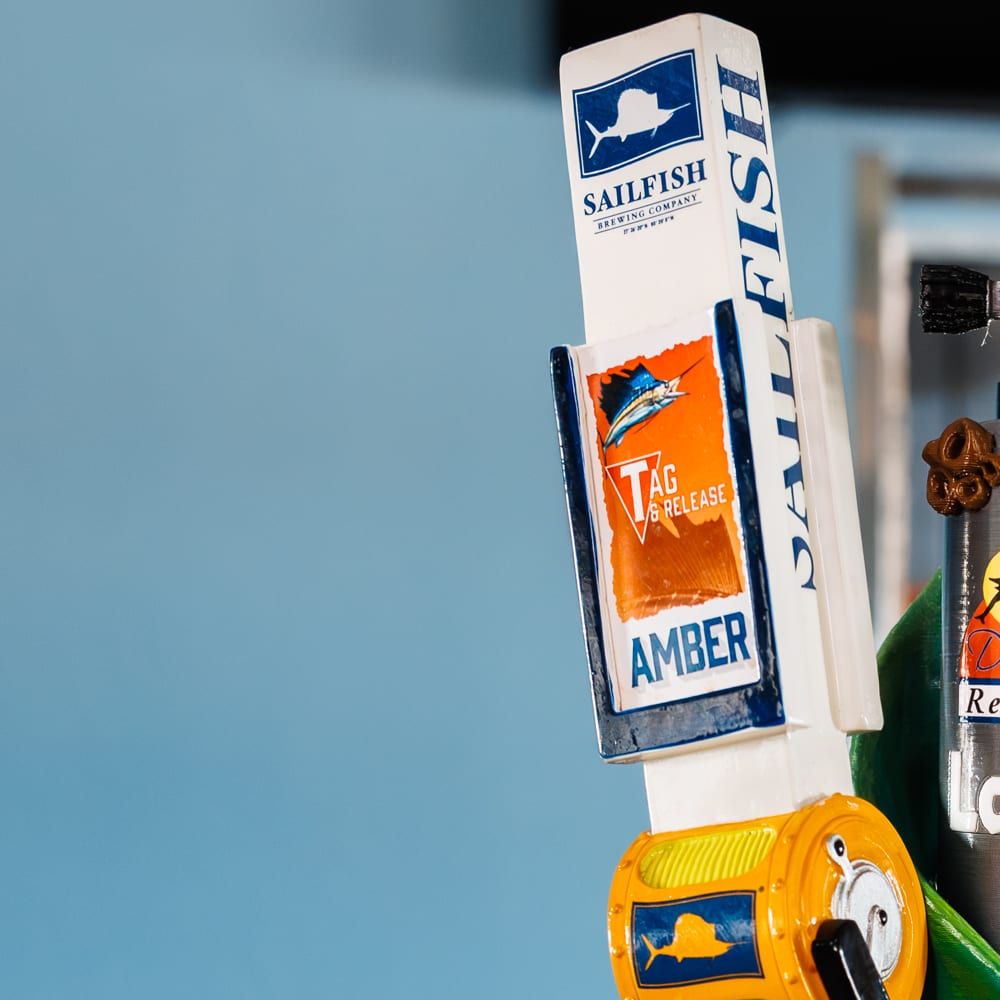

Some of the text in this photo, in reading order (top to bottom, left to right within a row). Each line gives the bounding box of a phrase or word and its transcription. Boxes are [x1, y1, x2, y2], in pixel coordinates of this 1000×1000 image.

[584, 158, 708, 217] SAILFISH
[596, 209, 646, 231] BREWING
[648, 193, 698, 216] COMPANY
[618, 458, 678, 523] TAG
[649, 482, 728, 521] & RELEASE
[630, 610, 751, 690] AMBER
